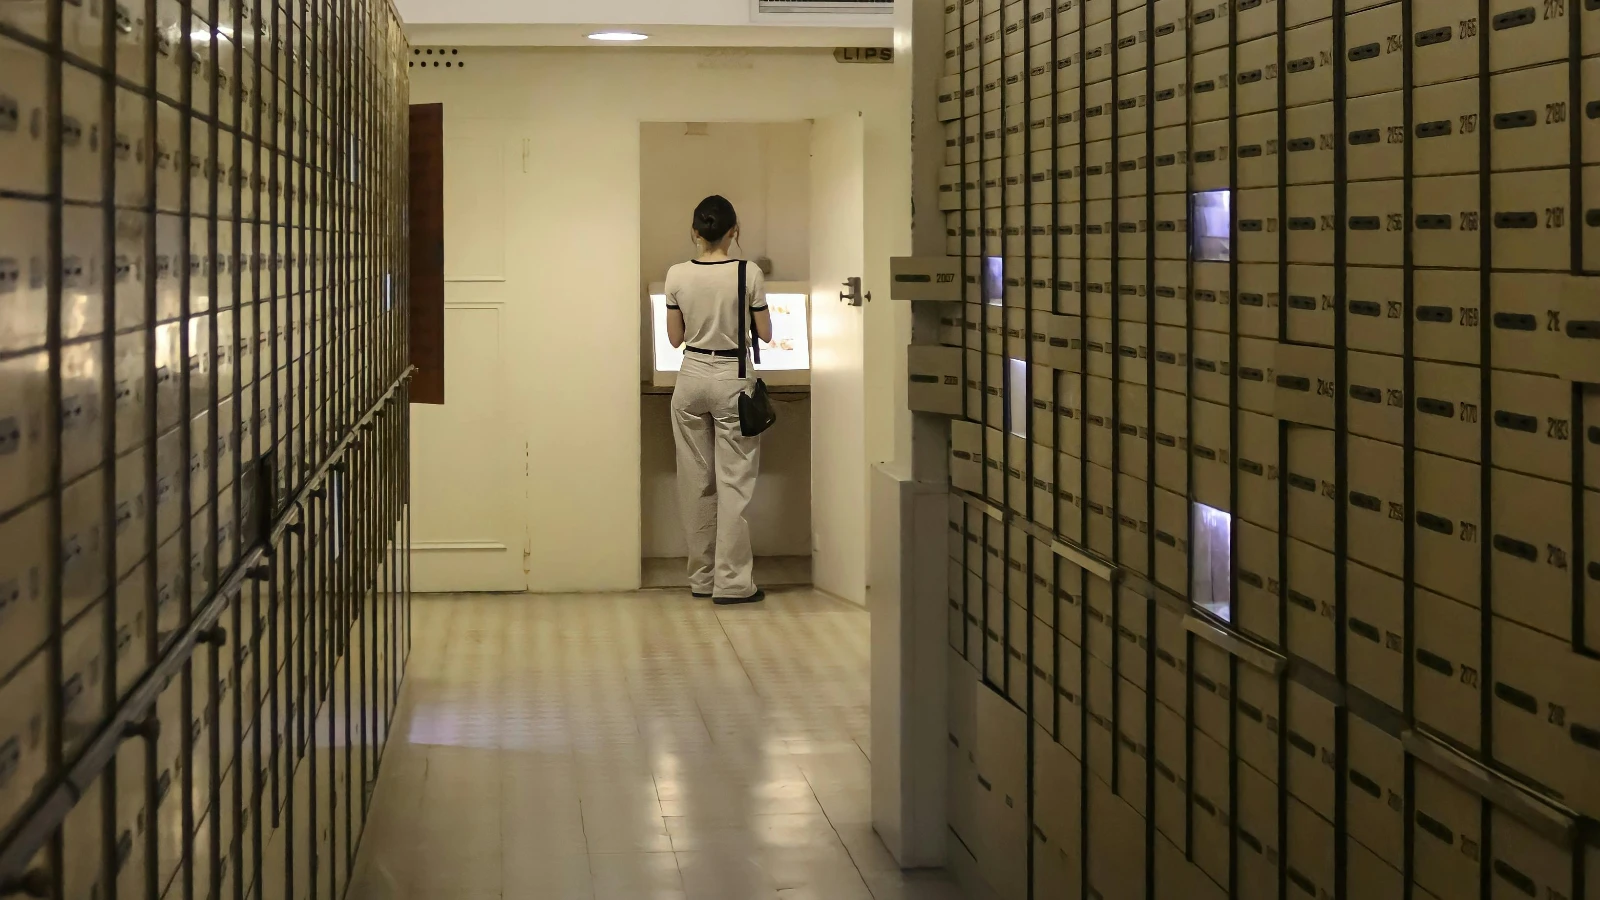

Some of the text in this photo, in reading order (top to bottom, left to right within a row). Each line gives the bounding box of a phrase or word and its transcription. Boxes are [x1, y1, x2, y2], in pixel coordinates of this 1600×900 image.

[843, 47, 892, 61] LIPS
[1459, 113, 1477, 135] 2167
[1545, 101, 1566, 125] 2180
[936, 273, 955, 284] 2007
[1459, 306, 1479, 328] 2169
[1317, 377, 1334, 398] 2145
[1460, 401, 1478, 424] 2170
